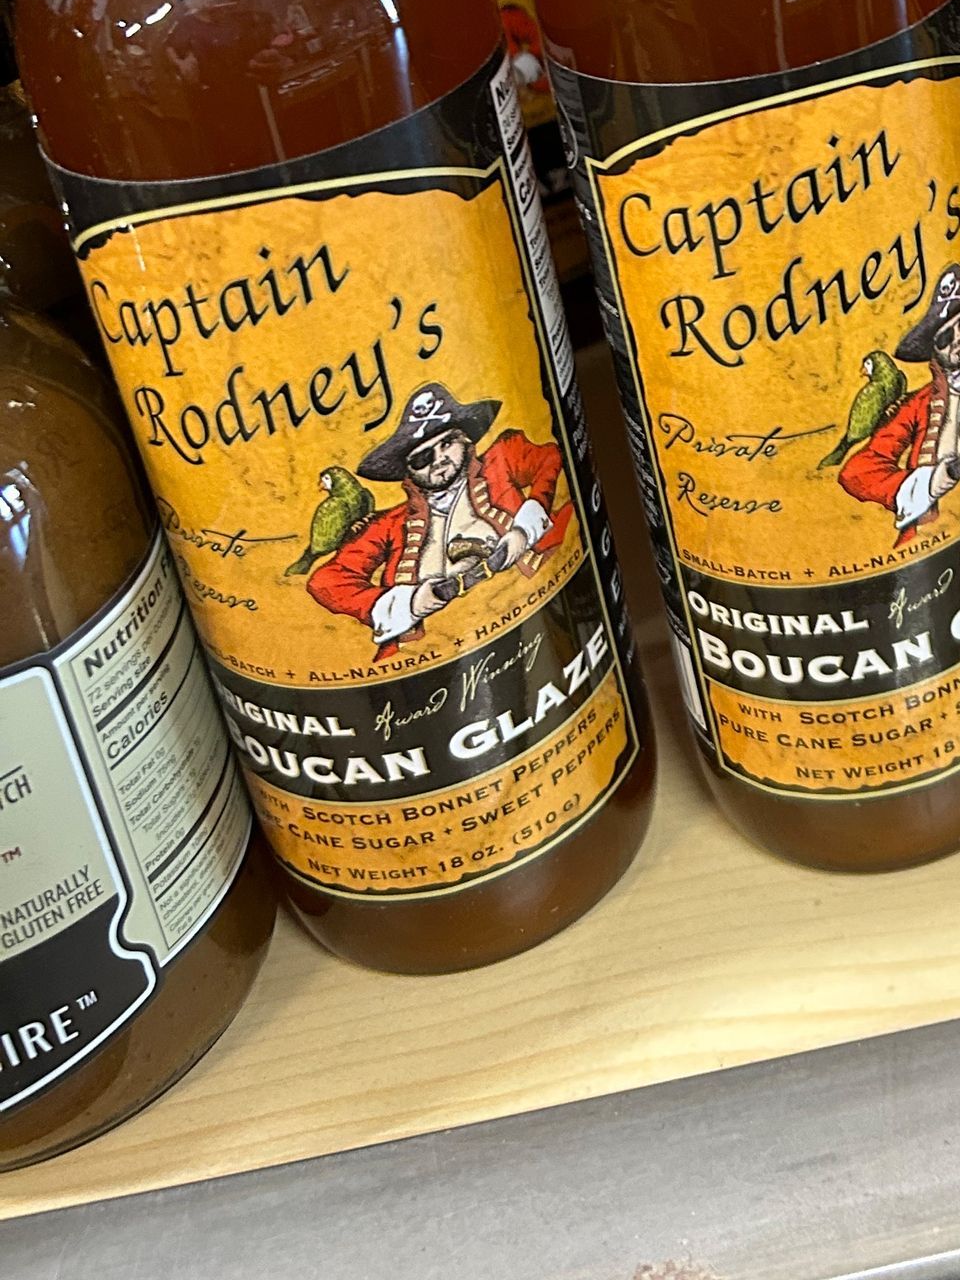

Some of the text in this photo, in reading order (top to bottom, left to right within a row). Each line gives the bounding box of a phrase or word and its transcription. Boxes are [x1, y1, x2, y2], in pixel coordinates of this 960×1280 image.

[619, 129, 901, 280] Captain
[90, 243, 352, 377] Captain
[134, 296, 444, 466] Rodney's
[656, 412, 837, 463] Private
[676, 470, 784, 517] Reserve
[682, 549, 792, 581] SMALL-BATCH
[828, 531, 952, 578] ALL-NATURAL
[83, 580, 164, 679] Nutrition
[309, 649, 443, 682] ALL-NATURAL
[475, 548, 583, 641] HAND-CRAFTED
[687, 590, 870, 636] ORIGINAL
[92, 655, 152, 718] Serving size
[218, 631, 546, 741] RIGINAL Award Winning
[448, 621, 609, 760] GLAZE
[698, 628, 935, 684] BOUCAN
[101, 708, 137, 744] Amount
[106, 690, 169, 761] Calories
[718, 713, 769, 743] PURE
[776, 733, 843, 750] CANE
[851, 717, 933, 747] SUGAR
[738, 703, 782, 722] WITH
[799, 704, 895, 726] SCOTCH
[288, 823, 345, 849] CANE
[352, 830, 437, 851] SUGAR
[461, 784, 544, 833] SWEET
[551, 709, 622, 788] PEPPERS
[302, 806, 393, 826] SCOTCH
[403, 778, 504, 823] BONNET
[512, 707, 599, 784] PEPPERS
[796, 766, 836, 780] NET
[844, 754, 924, 781] WEIGHT
[932, 740, 956, 758] 18
[307, 857, 342, 878] NET
[346, 864, 429, 882] WEIGHT
[438, 856, 466, 874] 18
[512, 810, 559, 846] (510
[0, 863, 92, 930] NATURALLY
[1, 878, 105, 950] GLUTEN FREE
[0, 1004, 81, 1070] IRE
